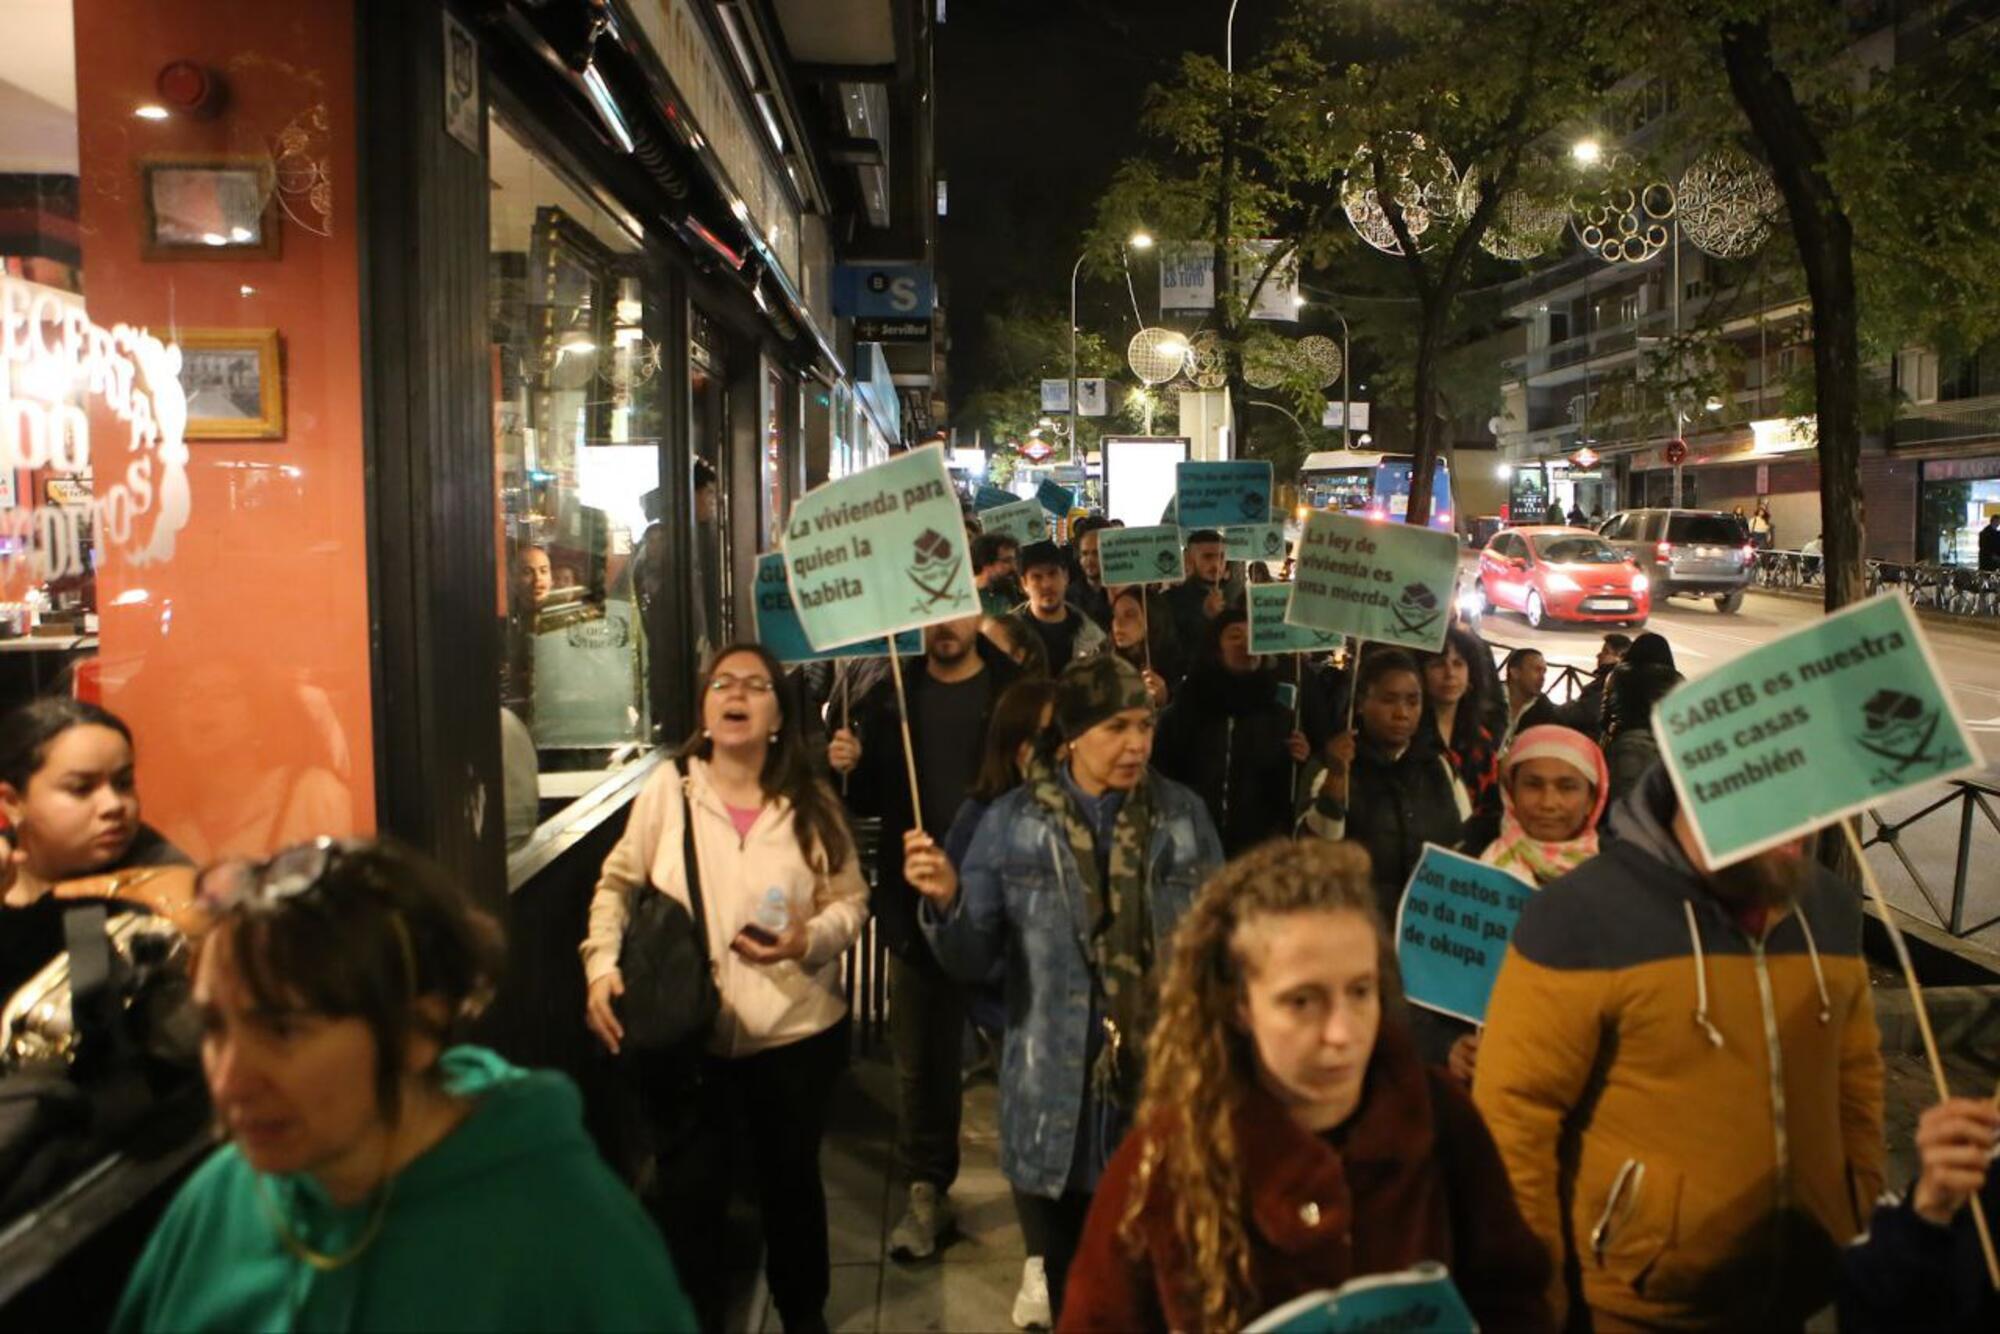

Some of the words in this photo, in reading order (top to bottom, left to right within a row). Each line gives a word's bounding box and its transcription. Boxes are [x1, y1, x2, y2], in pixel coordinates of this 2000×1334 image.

[790, 517, 811, 541] La
[813, 491, 899, 533] vivienda
[902, 478, 946, 513] para
[793, 546, 849, 578] quien
[854, 536, 873, 559] la
[1306, 527, 1325, 546] La
[1328, 530, 1353, 553] ley
[1356, 535, 1377, 555] de
[1302, 550, 1369, 580] vivienda
[1373, 567, 1395, 584] es
[800, 575, 864, 610] habita
[1297, 579, 1329, 597] una
[1331, 584, 1391, 609] mierda
[1668, 681, 1758, 737] SAREB
[1762, 669, 1795, 698] es
[1797, 628, 1907, 684] nuestra
[1680, 740, 1730, 771] sus
[1733, 704, 1812, 749] casas
[1693, 745, 1808, 806] también
[1415, 861, 1445, 888] Con
[1448, 875, 1501, 908] estos
[1407, 895, 1429, 916] no
[1433, 901, 1456, 926] da
[1461, 910, 1480, 933] ni
[1404, 923, 1426, 948] de
[1429, 933, 1486, 968] okupa
